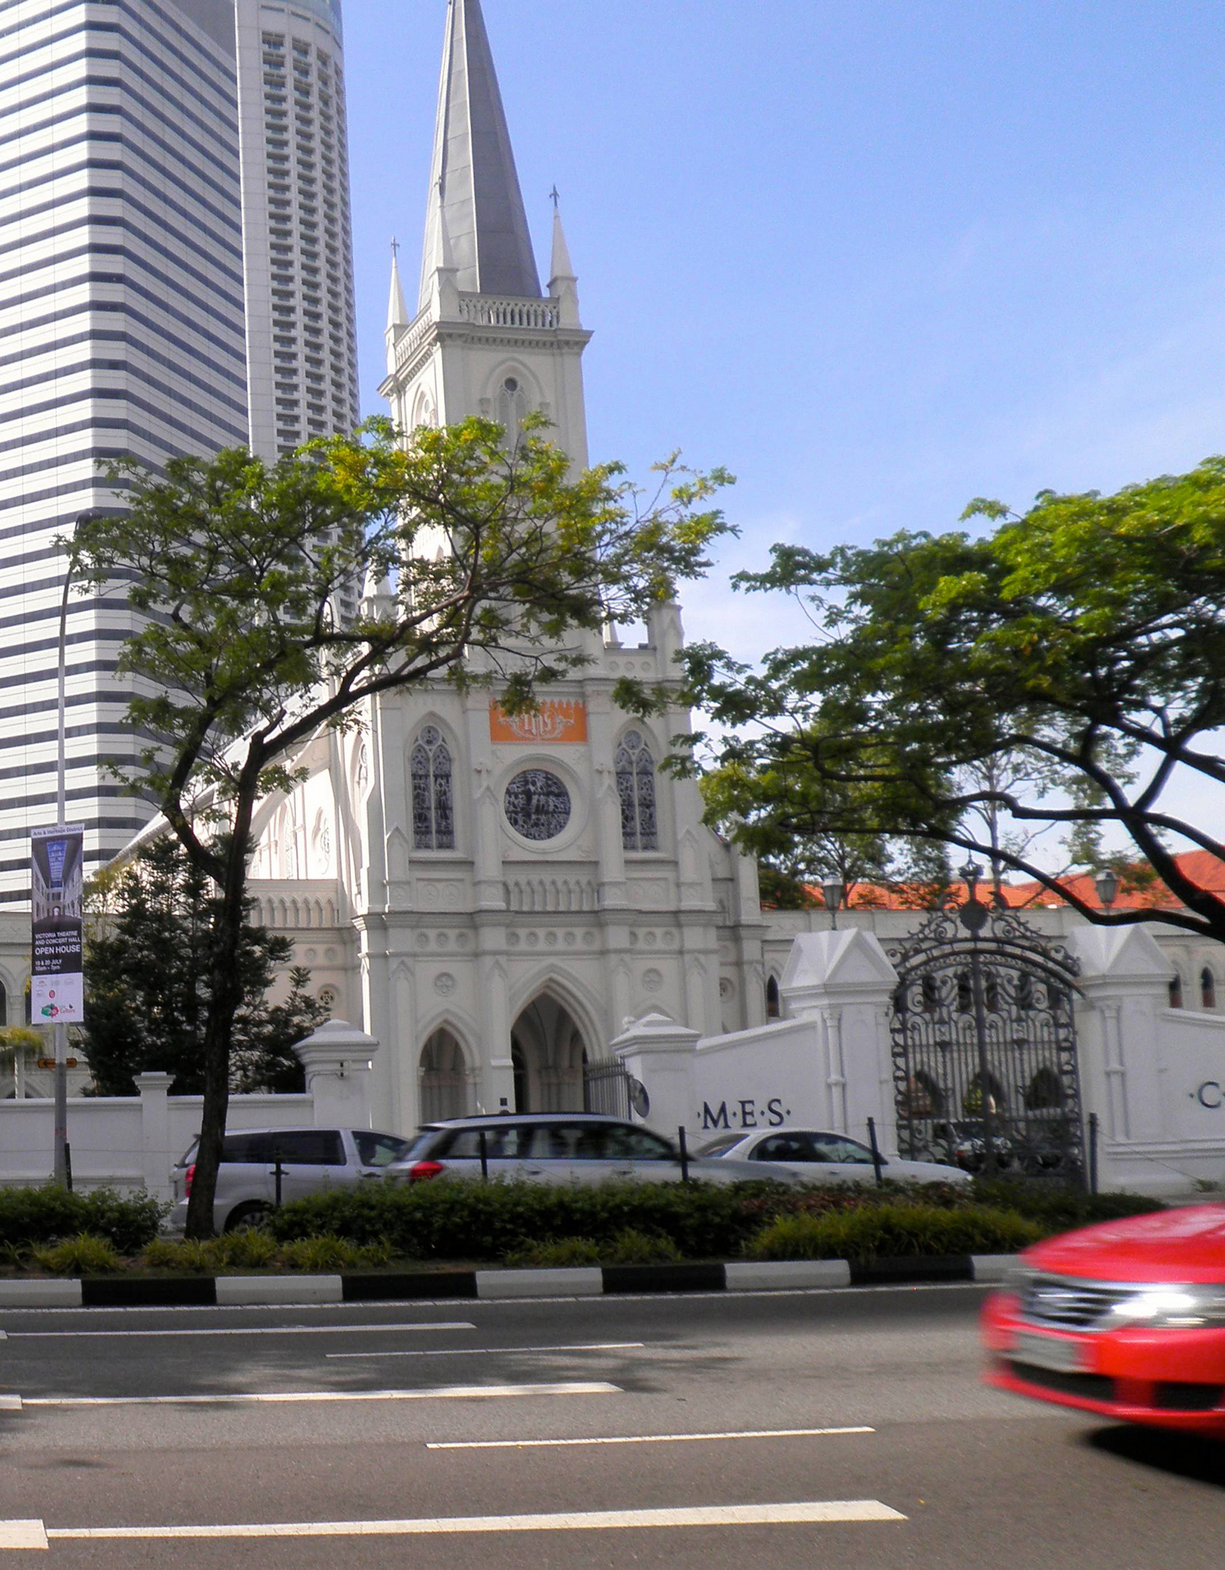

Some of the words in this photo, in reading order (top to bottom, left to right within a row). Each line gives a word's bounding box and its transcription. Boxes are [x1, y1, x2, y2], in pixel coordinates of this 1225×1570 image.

[45, 937, 67, 945] CONCERT
[35, 946, 55, 955] OPEN
[55, 945, 80, 953] HOUSE
